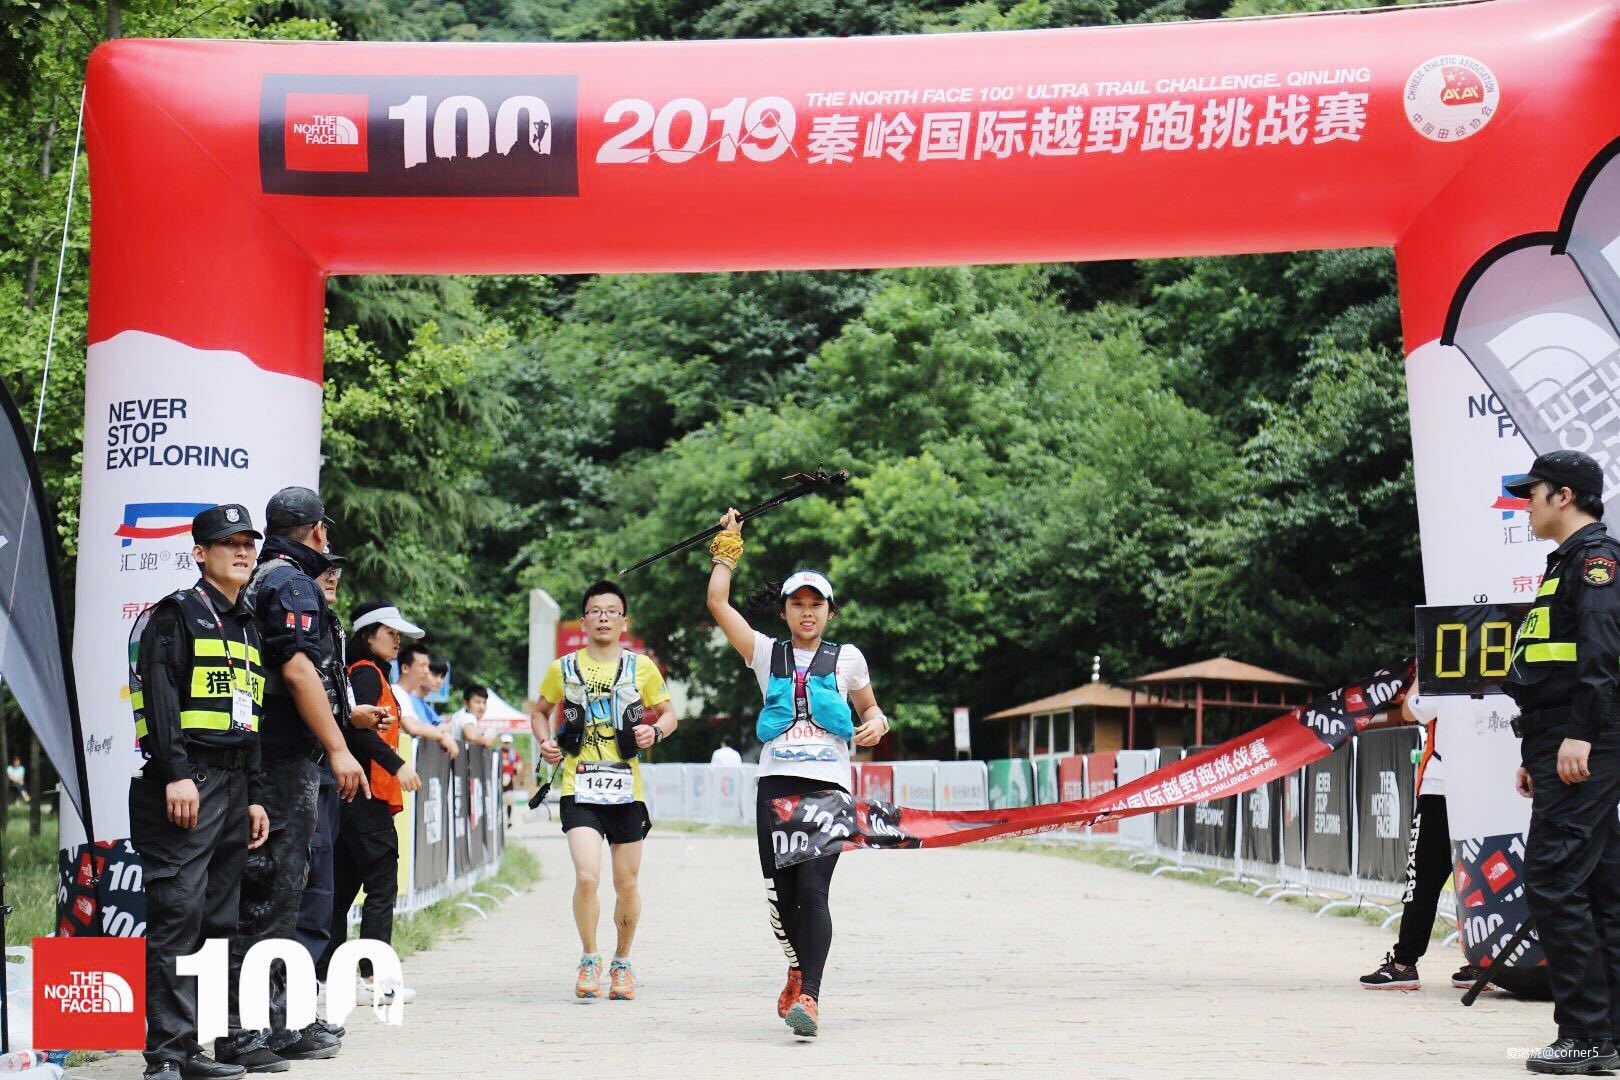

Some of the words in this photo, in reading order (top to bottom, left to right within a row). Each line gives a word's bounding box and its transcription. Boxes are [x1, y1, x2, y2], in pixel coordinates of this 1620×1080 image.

[805, 92, 844, 107] THE
[848, 89, 919, 106] NORTH
[922, 87, 974, 104] FACE
[1026, 82, 1090, 100] ULTRA
[1095, 79, 1151, 97] TRAIL
[1155, 72, 1281, 94] CHALLENGE.
[1286, 67, 1371, 88] QINLING
[1407, 71, 1425, 100] CHINESE
[1423, 57, 1457, 73] ATHLETIC
[1459, 58, 1495, 93] ASSOCIATION
[293, 123, 336, 135] NORTH
[312, 114, 336, 125] THE
[388, 95, 552, 169] 100
[595, 96, 797, 165] 2019
[806, 91, 1369, 165] 秦岭国际越野跑挑战赛
[1413, 105, 1494, 139] 中国田径协会
[305, 134, 336, 145] FACE
[108, 398, 187, 424] NEVER
[1468, 393, 1508, 418] NO
[107, 421, 168, 447] STOP
[106, 444, 249, 470] EXPLORING
[1435, 621, 1512, 678] 08
[1366, 679, 1403, 706] 100
[1306, 709, 1346, 736] 100
[586, 777, 623, 790] 1474
